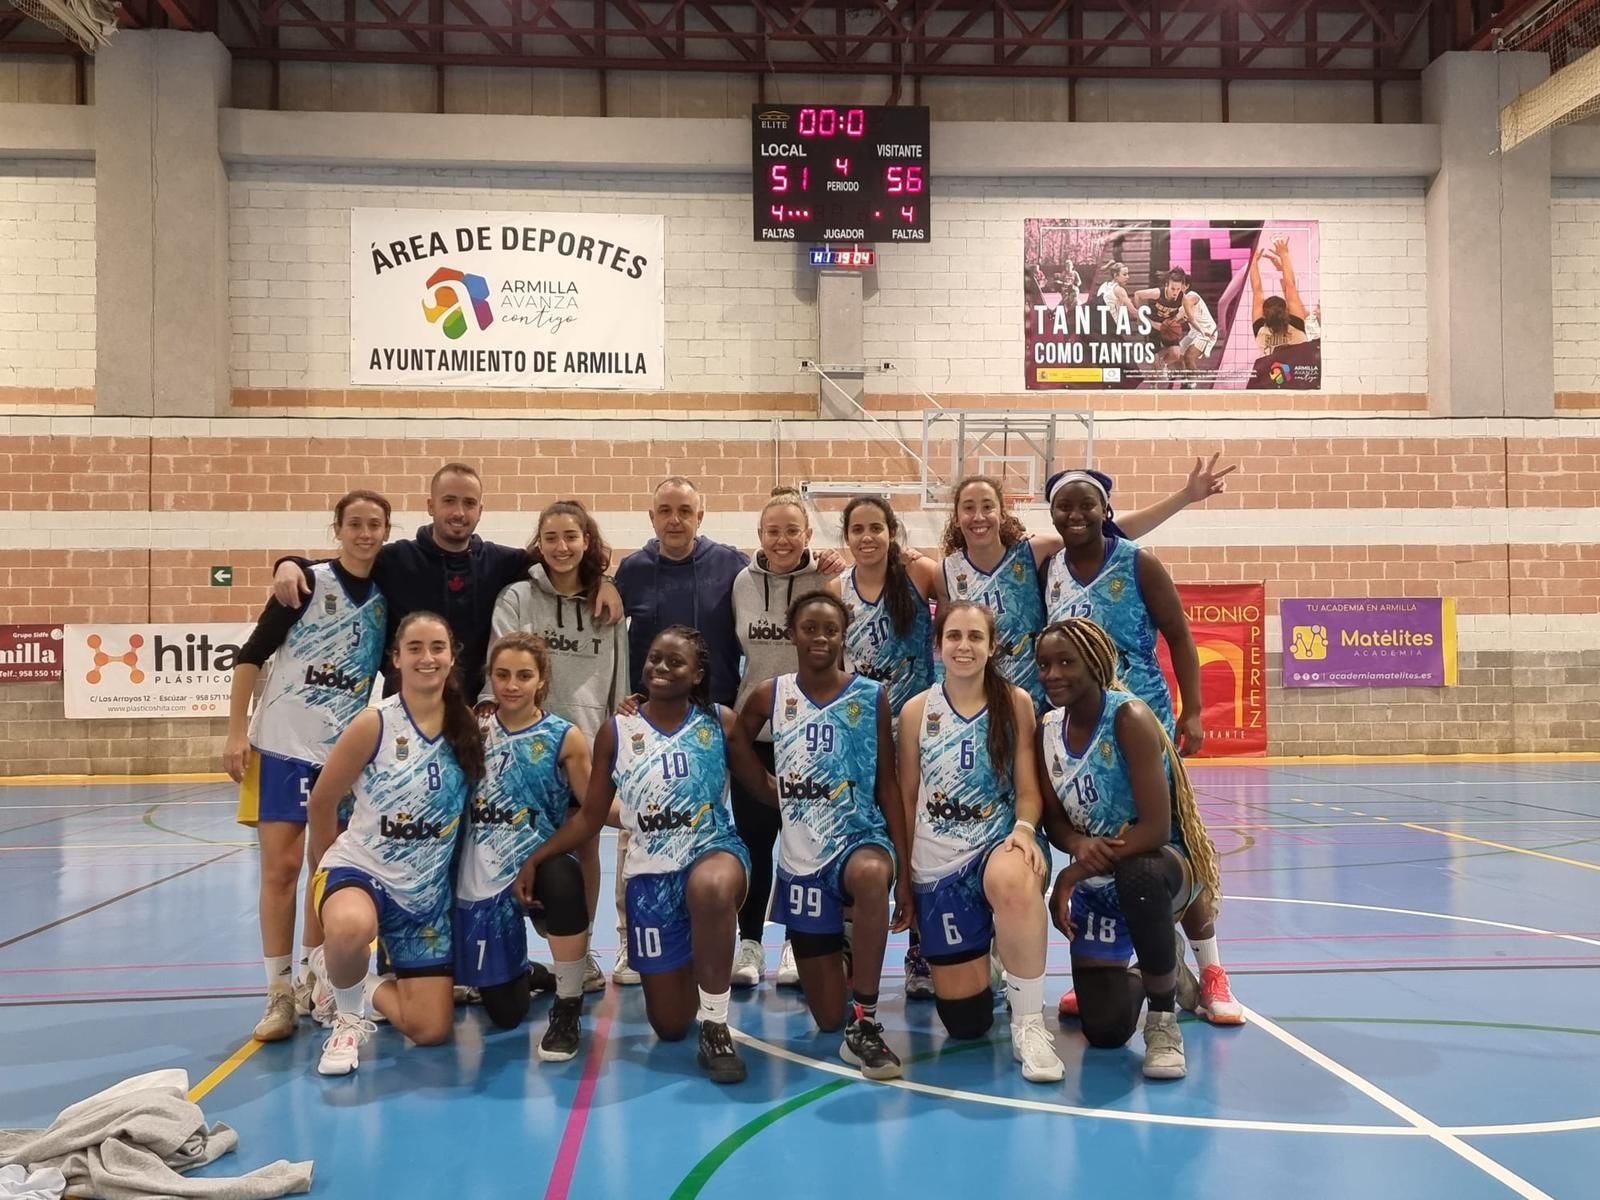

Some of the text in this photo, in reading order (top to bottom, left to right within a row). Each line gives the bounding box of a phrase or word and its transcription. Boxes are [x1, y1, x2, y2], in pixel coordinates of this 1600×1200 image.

[761, 121, 787, 129] ELITE
[760, 144, 807, 157] LOCAL
[877, 144, 923, 158] VISITANTE
[771, 165, 808, 191] 51
[835, 158, 848, 176] 4
[887, 166, 923, 192] 56
[826, 181, 860, 192] PERIODO
[901, 205, 914, 223] 4
[762, 228, 795, 239] FALTAS
[823, 228, 865, 240] JUGADOR
[892, 229, 924, 239] FALTAS
[370, 225, 648, 280] ÁREA DE DEPORTES
[501, 280, 579, 294] ARMILLA
[501, 295, 579, 310] AVANZA
[501, 305, 578, 334] contigo
[1034, 305, 1153, 336] TANTAS
[369, 347, 647, 375] AYUNTAMIENTO DE ARMILLA
[1034, 342, 1155, 364] COMO TANTOS
[983, 590, 1006, 615] 11
[1184, 605, 1260, 622] NTONIO
[1306, 603, 1417, 612] TU ACADEMIA EN ARMILLA
[352, 621, 361, 647] 5
[867, 616, 890, 646] 30
[153, 633, 242, 672] hita
[1353, 649, 1423, 657] ACADEMIA
[154, 674, 232, 684] PLÁSTICO
[1249, 625, 1262, 729] PEREZ
[1329, 671, 1432, 681] academiamatelites.es
[107, 704, 187, 713] www.plasticoshita.com
[113, 695, 142, 704] Arroyos
[159, 694, 187, 702] Escúzar
[805, 723, 834, 753] 99
[498, 751, 511, 777] 7
[661, 752, 689, 780] 10
[960, 739, 975, 770] 6
[427, 762, 441, 791] 8
[1072, 774, 1099, 806] 18
[789, 884, 822, 918] 99
[941, 912, 963, 946] 6
[1083, 911, 1116, 944] 18
[634, 926, 662, 958] 10
